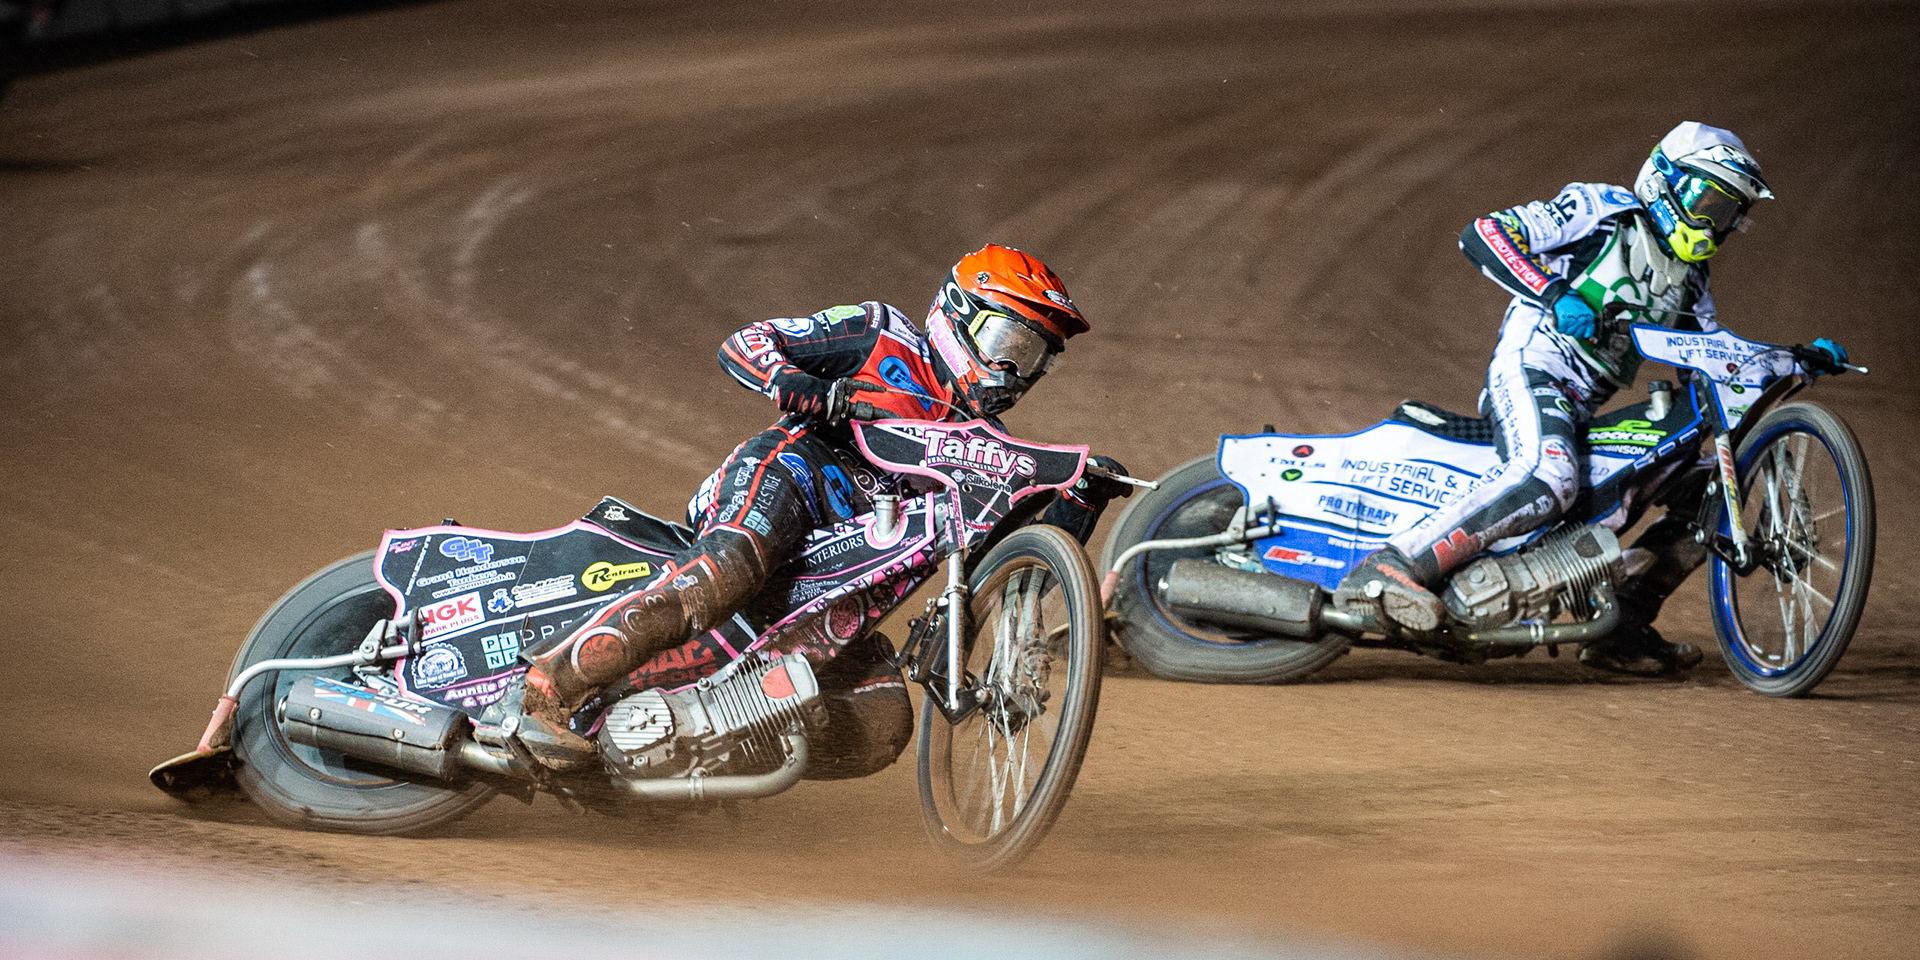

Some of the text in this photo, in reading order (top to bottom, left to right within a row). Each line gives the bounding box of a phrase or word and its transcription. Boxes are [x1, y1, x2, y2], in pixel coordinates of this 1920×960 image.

[1489, 234, 1543, 287] PROTECTION
[1666, 337, 1729, 350] INDUSTRIAL
[1733, 342, 1744, 352] &
[1678, 349, 1702, 362] LIFT
[1705, 349, 1756, 365] SERVICES
[1587, 431, 1660, 442] ROCK OIL
[924, 430, 1035, 477] Taffys
[966, 474, 1012, 493] Silkolene
[1341, 459, 1436, 483] INDUSTRIAL
[1445, 475, 1458, 489] &
[1350, 474, 1387, 488] LIFT
[1389, 477, 1450, 504] SERVIC
[1318, 495, 1399, 523] PRO THERAPY
[805, 534, 865, 568] INTERIORS
[416, 556, 527, 587] Grant Henderson
[447, 570, 498, 587] Tankers
[588, 566, 647, 585] Rentruck
[424, 597, 477, 624] NGK
[422, 614, 480, 637] PARK PLUGS
[629, 640, 716, 679] MAC
[630, 663, 719, 690] TOOLS
[444, 682, 499, 701] Auntie
[462, 696, 477, 707] &
